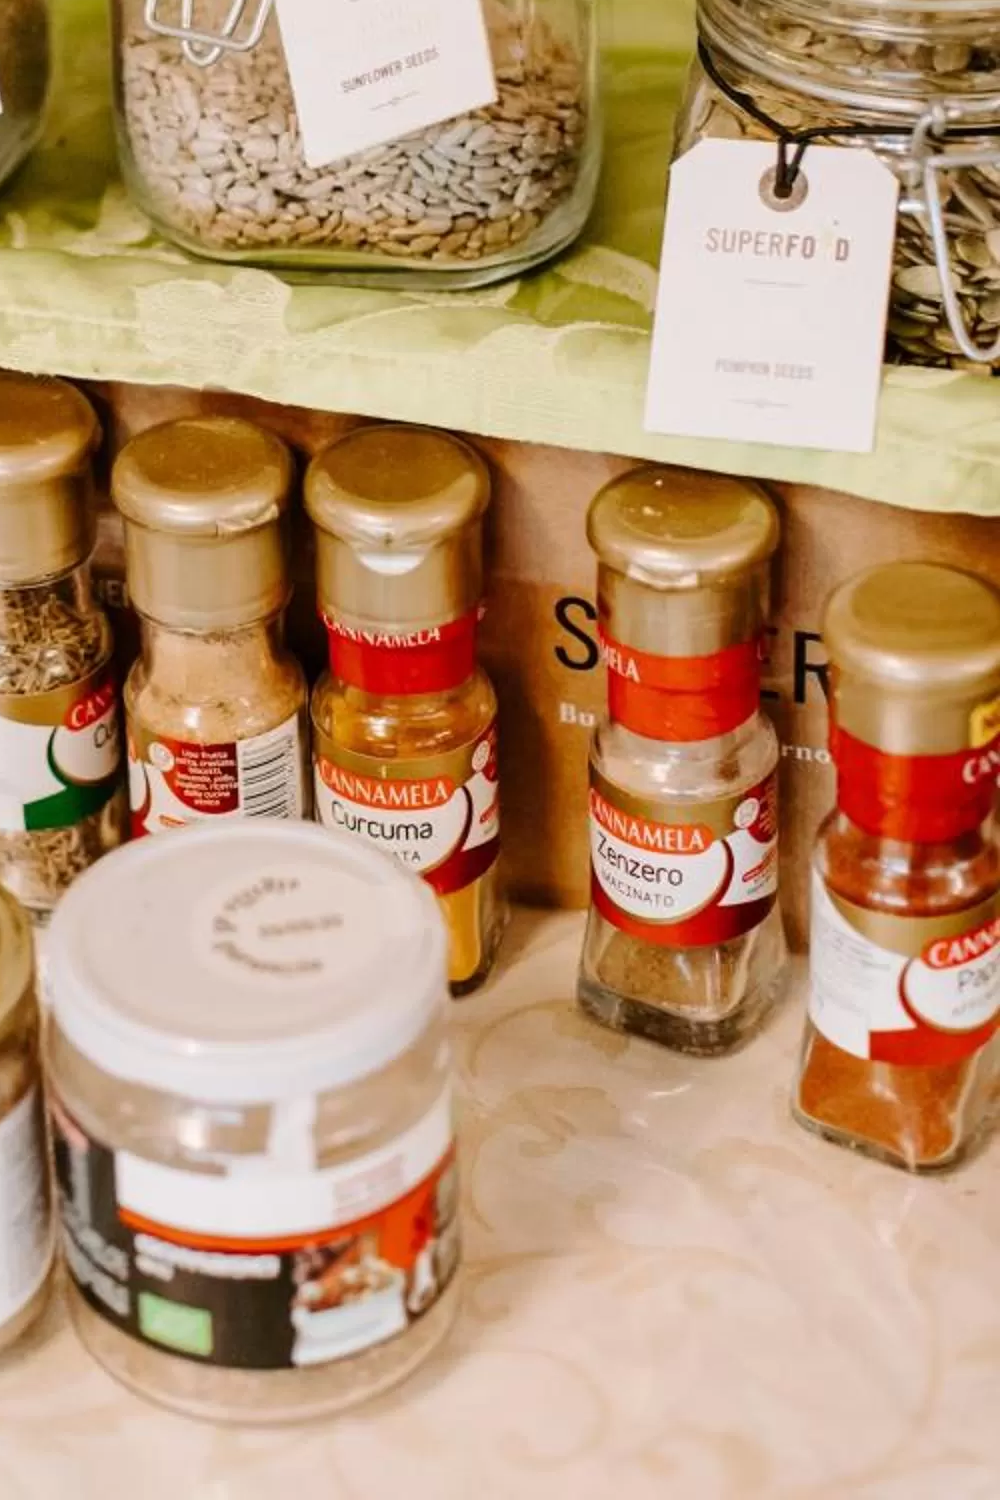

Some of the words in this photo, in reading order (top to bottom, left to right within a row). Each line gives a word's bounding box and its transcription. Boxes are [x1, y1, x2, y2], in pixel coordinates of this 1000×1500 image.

[340, 62, 402, 93] SUNFLOWER
[405, 47, 439, 69] SEEDS
[705, 226, 850, 262] SUPERFOD
[321, 758, 449, 807] CANNAMELA
[331, 800, 433, 841] Curcuma
[593, 795, 705, 851] ANNAMELA
[596, 832, 684, 887] Zenzero
